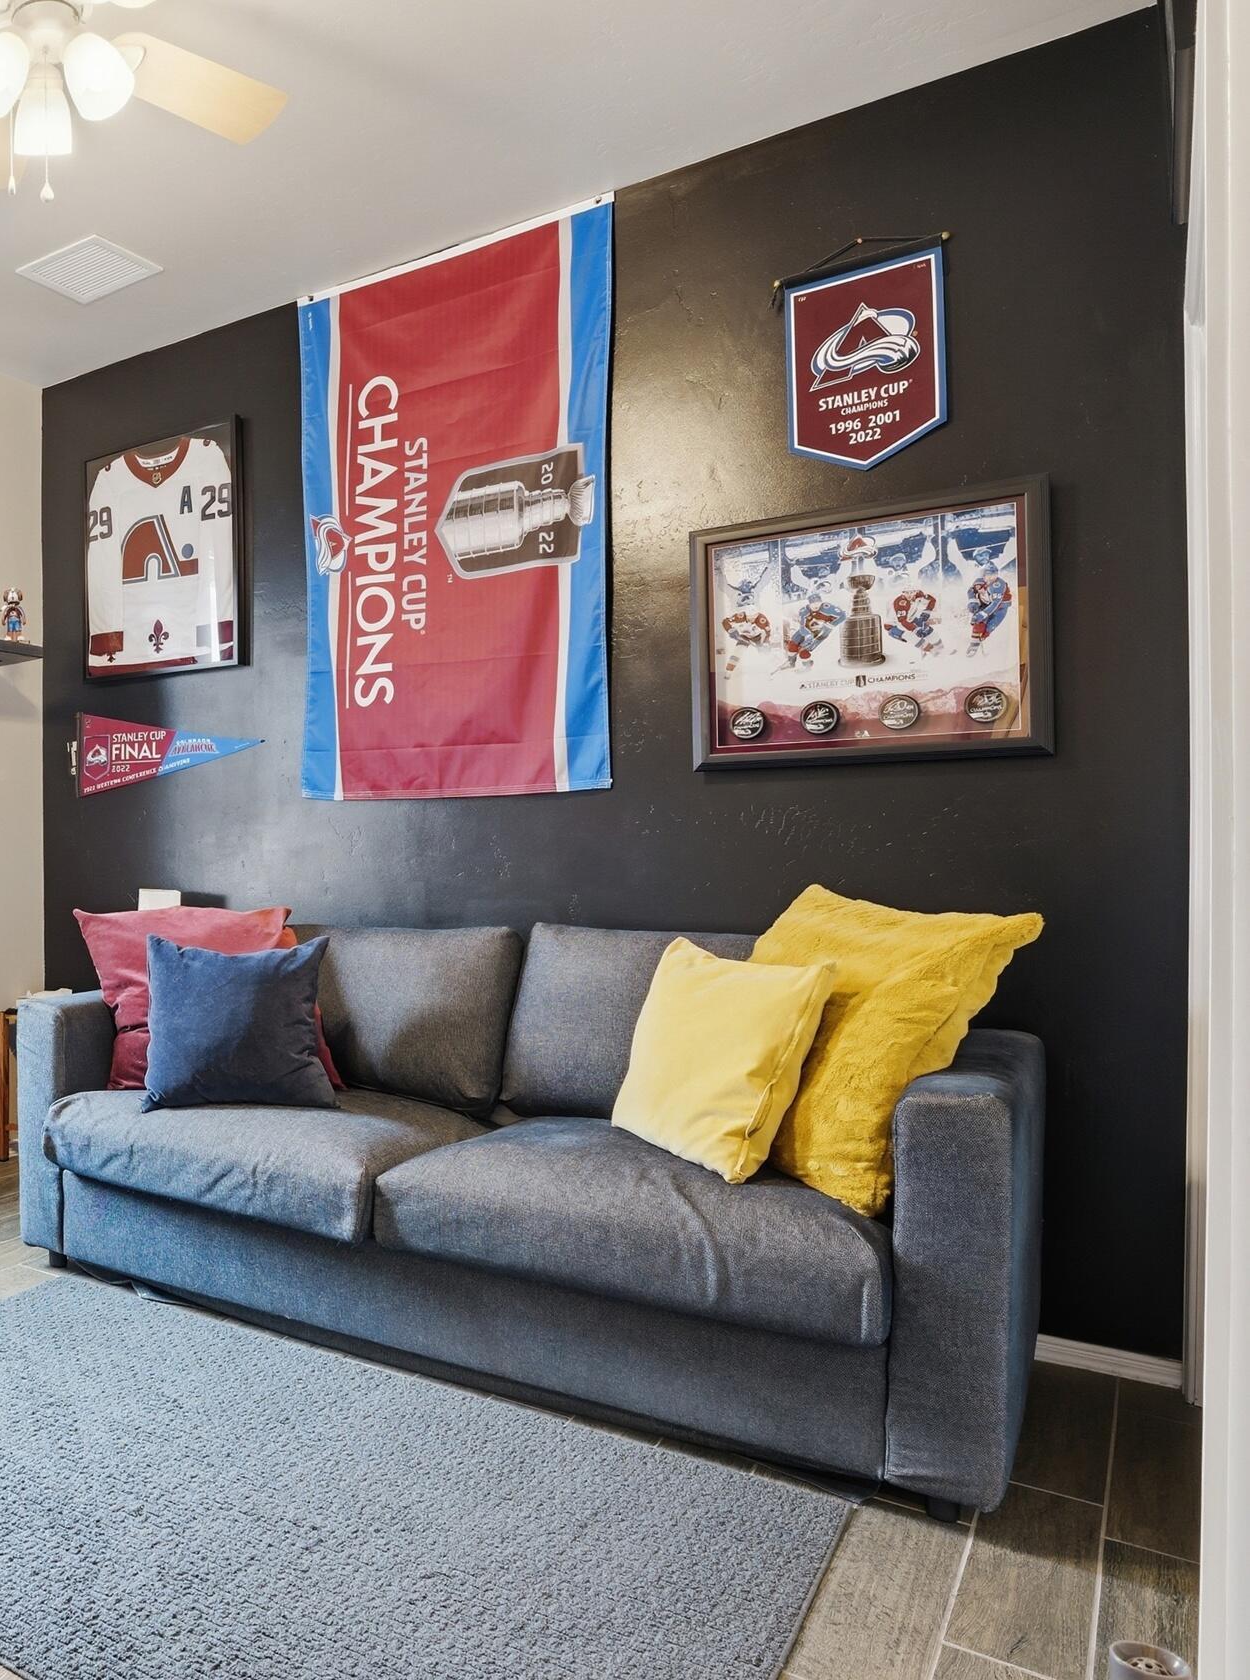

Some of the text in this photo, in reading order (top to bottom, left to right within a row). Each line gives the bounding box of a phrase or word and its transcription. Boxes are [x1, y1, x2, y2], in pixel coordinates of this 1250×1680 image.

[818, 380, 909, 412] STANLEY CUP
[840, 399, 889, 416] CHAMPIONS
[829, 409, 901, 435] 1996 2001
[848, 428, 882, 445] 2022
[179, 485, 193, 515] A
[201, 482, 232, 521] 29
[539, 462, 554, 554] 20 22
[88, 506, 113, 542] 29
[400, 437, 428, 631] STANLEY CUP
[352, 375, 399, 708] CHAMPIONS
[867, 673, 916, 684] CHAMPIONS
[112, 730, 167, 743] STANLEY CUP
[111, 743, 161, 761] FINAL
[111, 764, 130, 773] 2022
